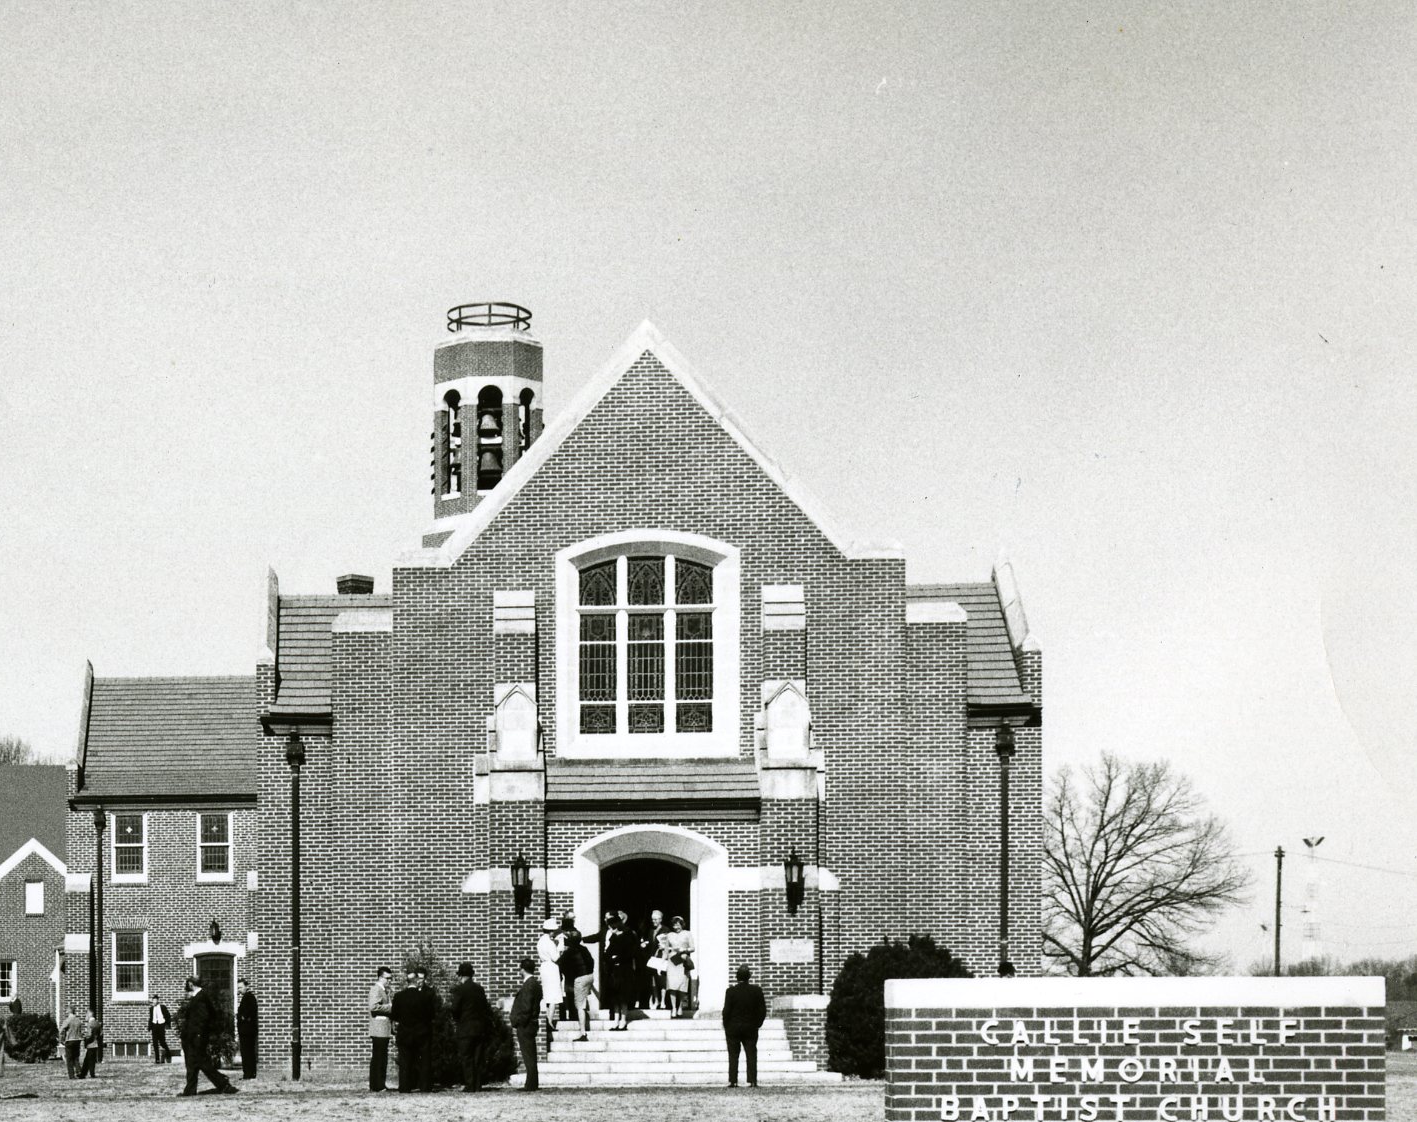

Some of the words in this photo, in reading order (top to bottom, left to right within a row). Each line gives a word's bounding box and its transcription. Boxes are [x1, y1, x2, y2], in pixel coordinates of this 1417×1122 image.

[980, 1019, 1141, 1046] CALLIE
[1182, 1019, 1297, 1046] SELF
[1010, 1057, 1266, 1084] MEMORIAL
[940, 1096, 1131, 1122] BAPTIST
[1158, 1096, 1337, 1122] CHURCH
